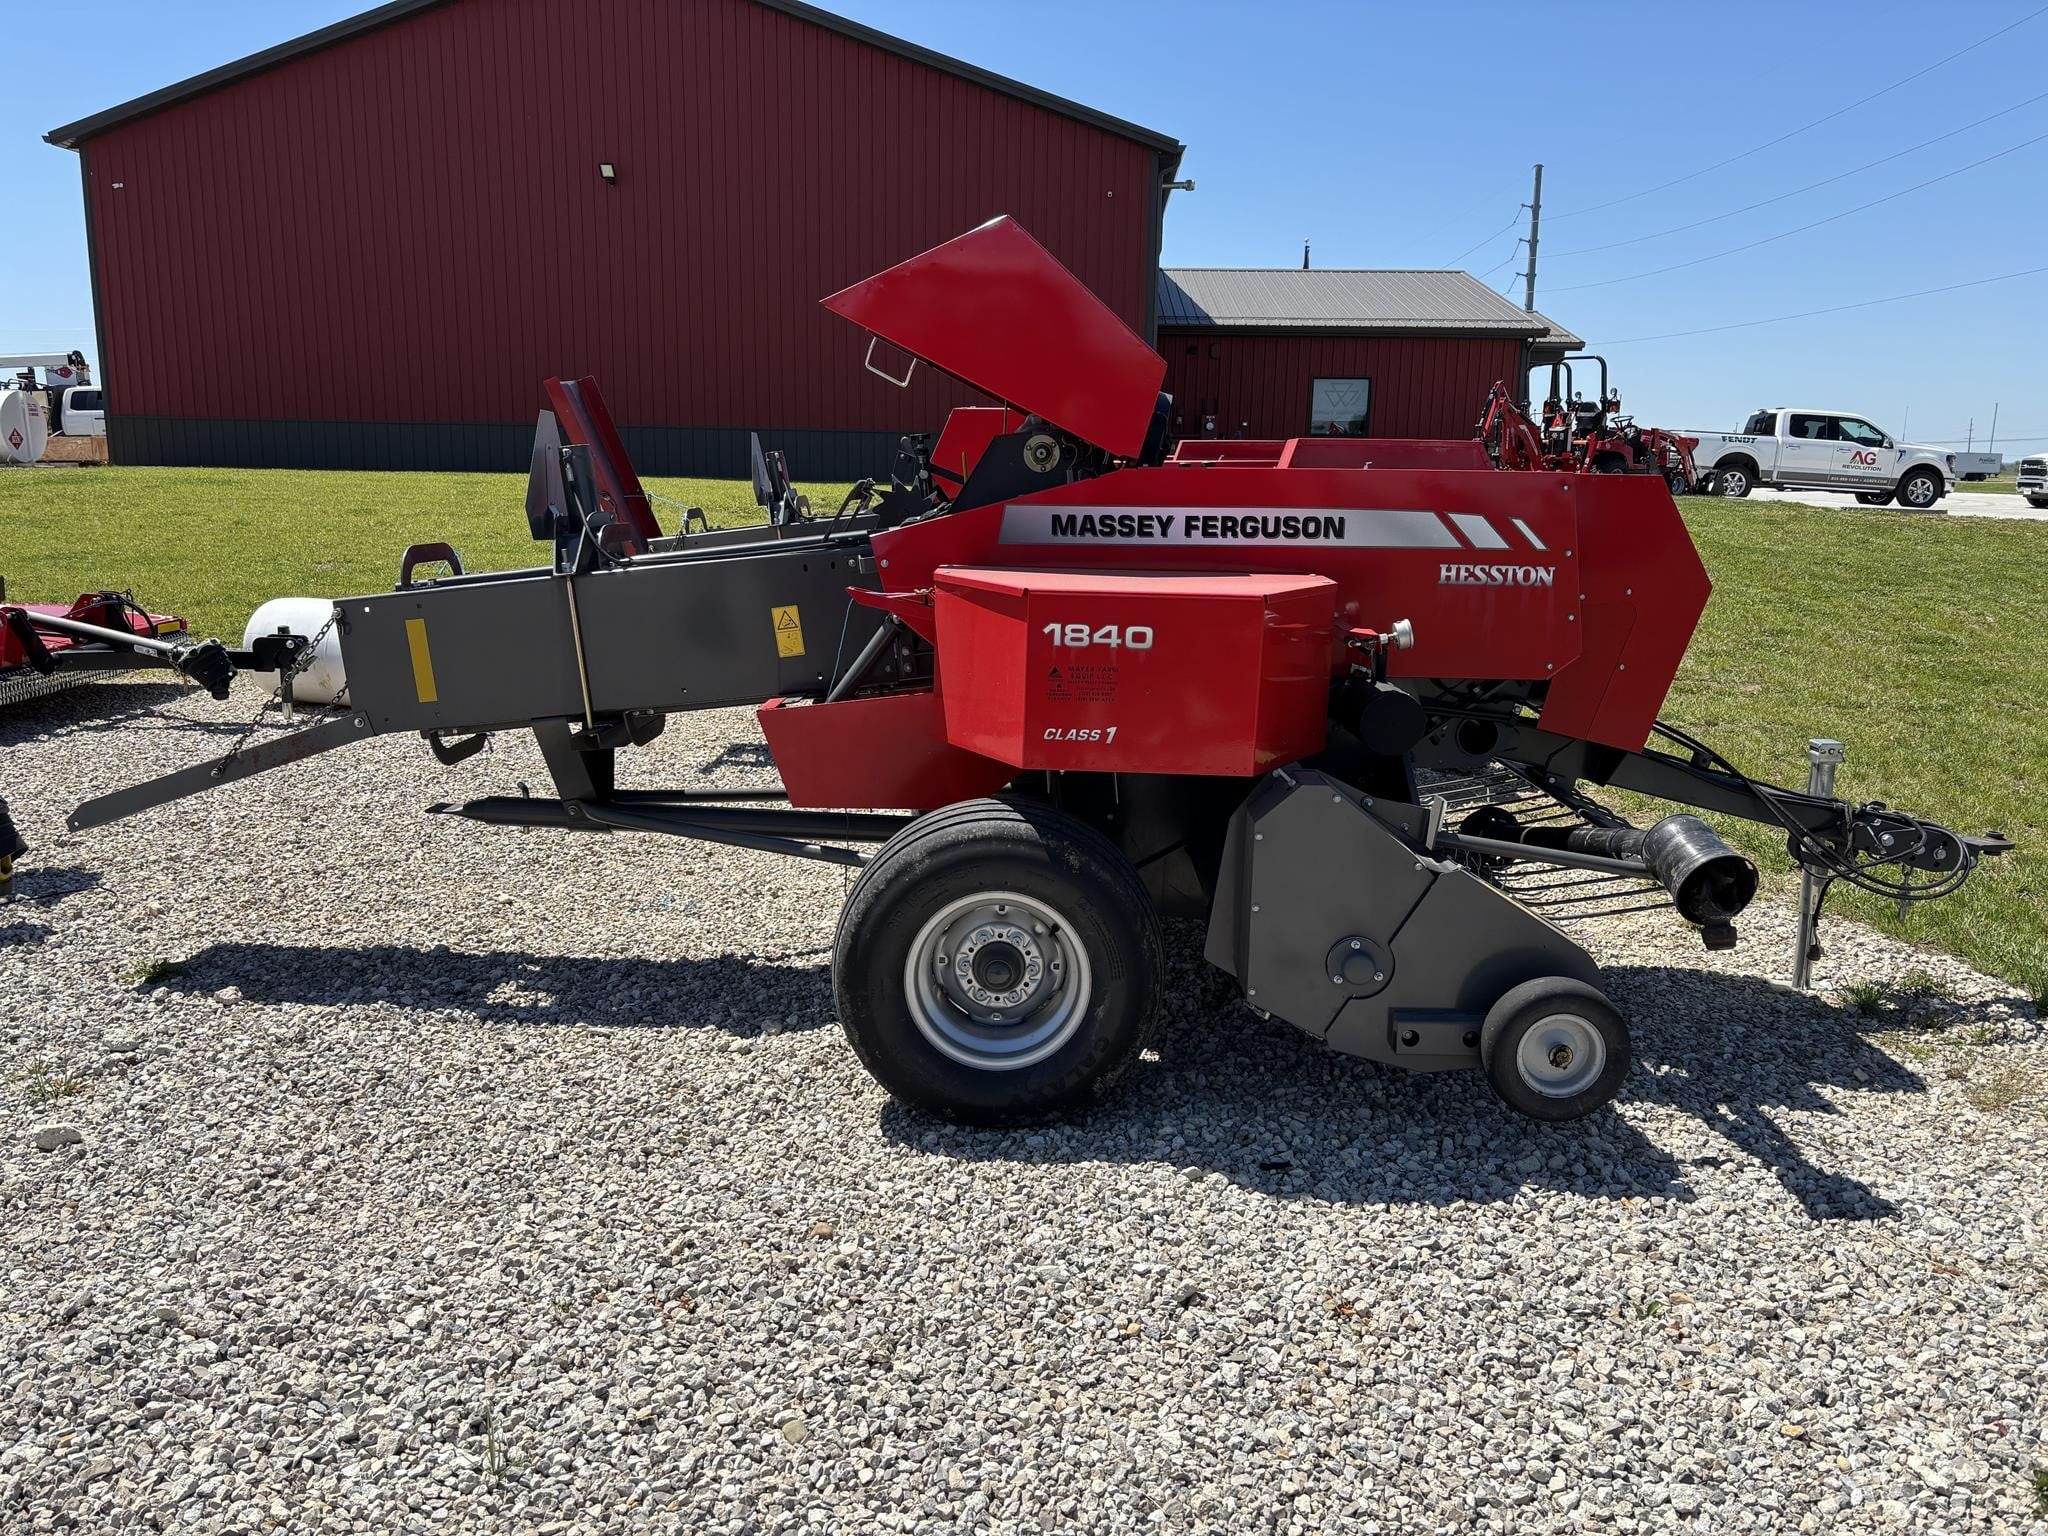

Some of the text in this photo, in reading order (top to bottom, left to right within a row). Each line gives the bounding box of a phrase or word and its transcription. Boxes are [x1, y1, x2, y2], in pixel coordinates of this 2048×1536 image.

[1721, 435, 1758, 444] FENDT
[1849, 450, 1877, 465] AG
[1842, 463, 1882, 472] REVOLUTION
[1051, 514, 1346, 540] MASSEY FERGUSON
[1438, 564, 1556, 587] HESSTON
[1043, 623, 1154, 650] 1840
[1043, 726, 1118, 744] CLASS 1
